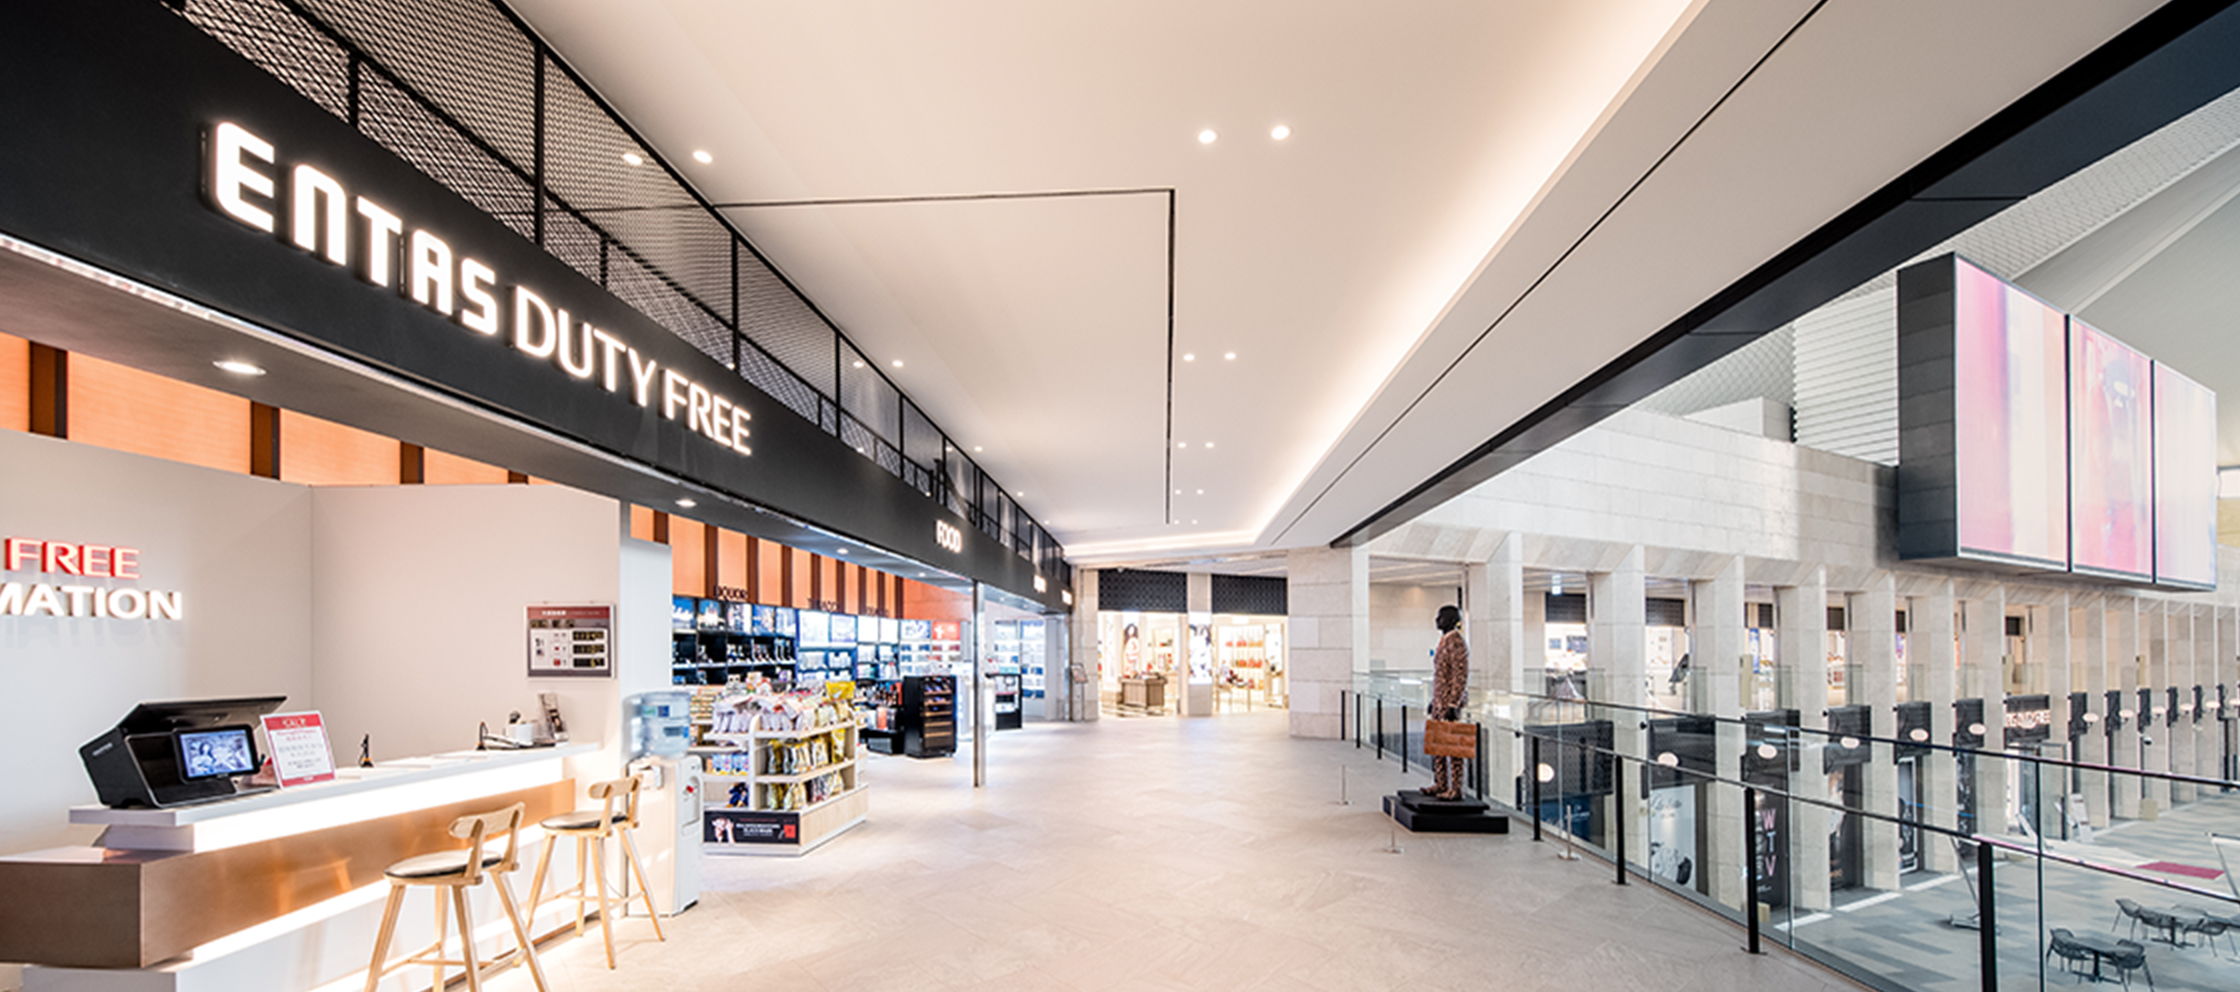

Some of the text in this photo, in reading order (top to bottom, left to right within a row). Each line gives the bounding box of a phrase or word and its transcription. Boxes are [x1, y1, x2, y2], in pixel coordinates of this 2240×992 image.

[216, 121, 752, 456] ENTAS DUTY FREE
[935, 519, 963, 553] FOOD
[4, 537, 141, 580] FREE
[0, 582, 182, 620] MATION
